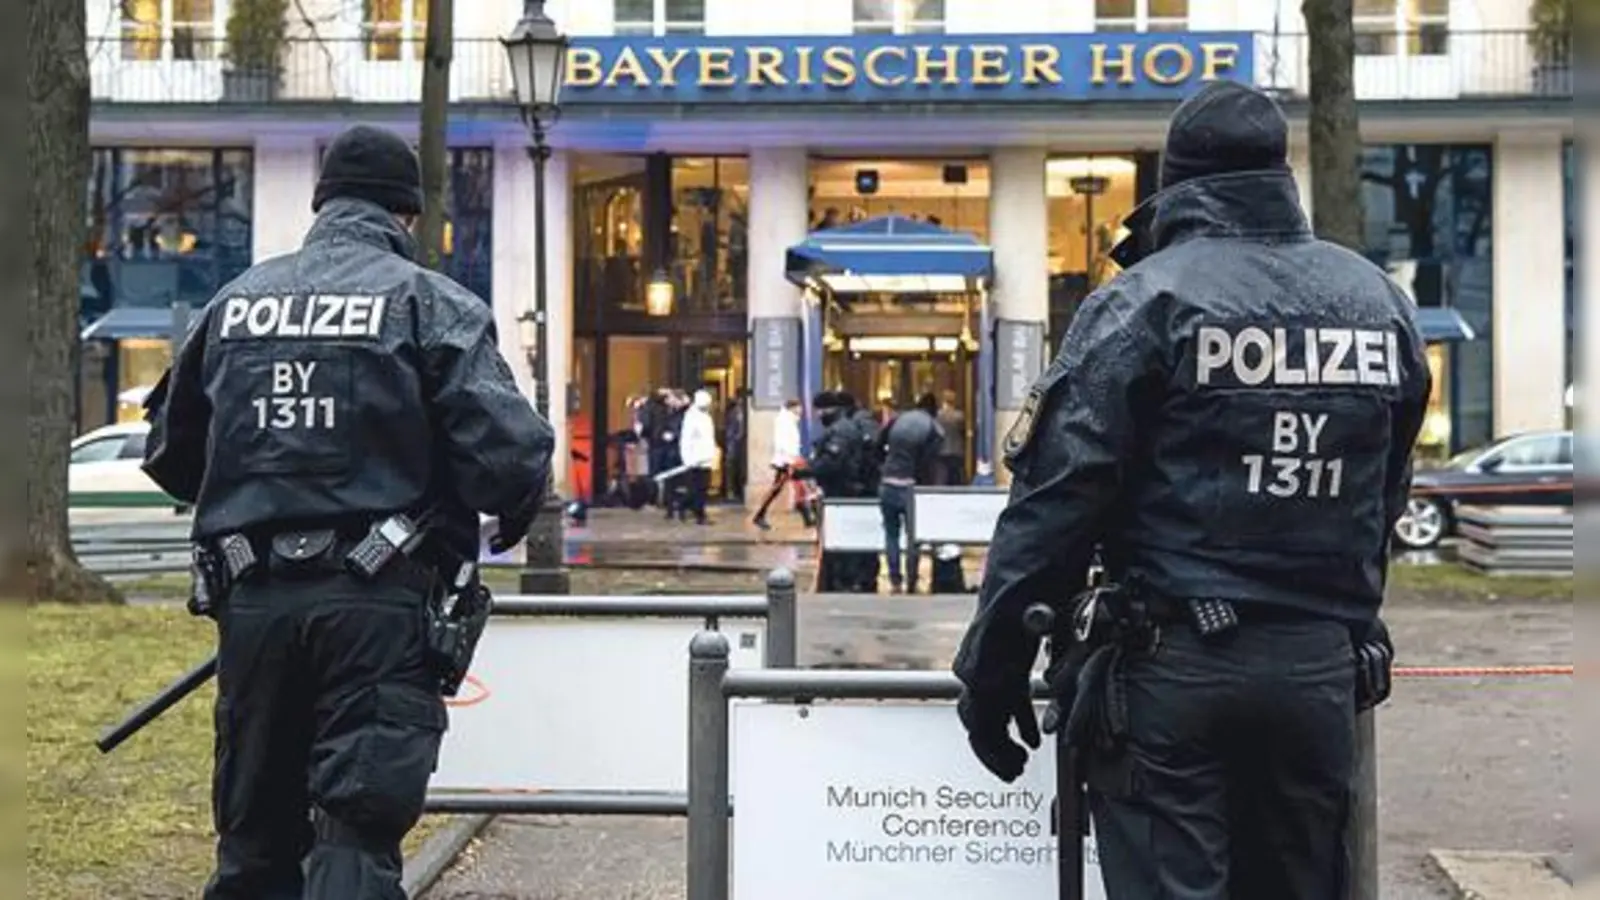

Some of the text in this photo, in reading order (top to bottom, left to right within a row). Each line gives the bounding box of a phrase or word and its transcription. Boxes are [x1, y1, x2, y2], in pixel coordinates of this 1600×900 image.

[563, 43, 1240, 87] BAYERISCHER HOF
[220, 295, 385, 338] POLIZEI
[1196, 326, 1400, 385] POLIZEI
[271, 361, 317, 394] BY
[252, 397, 335, 429] 1311
[1273, 411, 1329, 454] BY
[1241, 454, 1343, 497] 1311
[826, 785, 1044, 813] Munich Security
[881, 813, 1042, 838] Conference
[826, 840, 955, 864] Münchner
